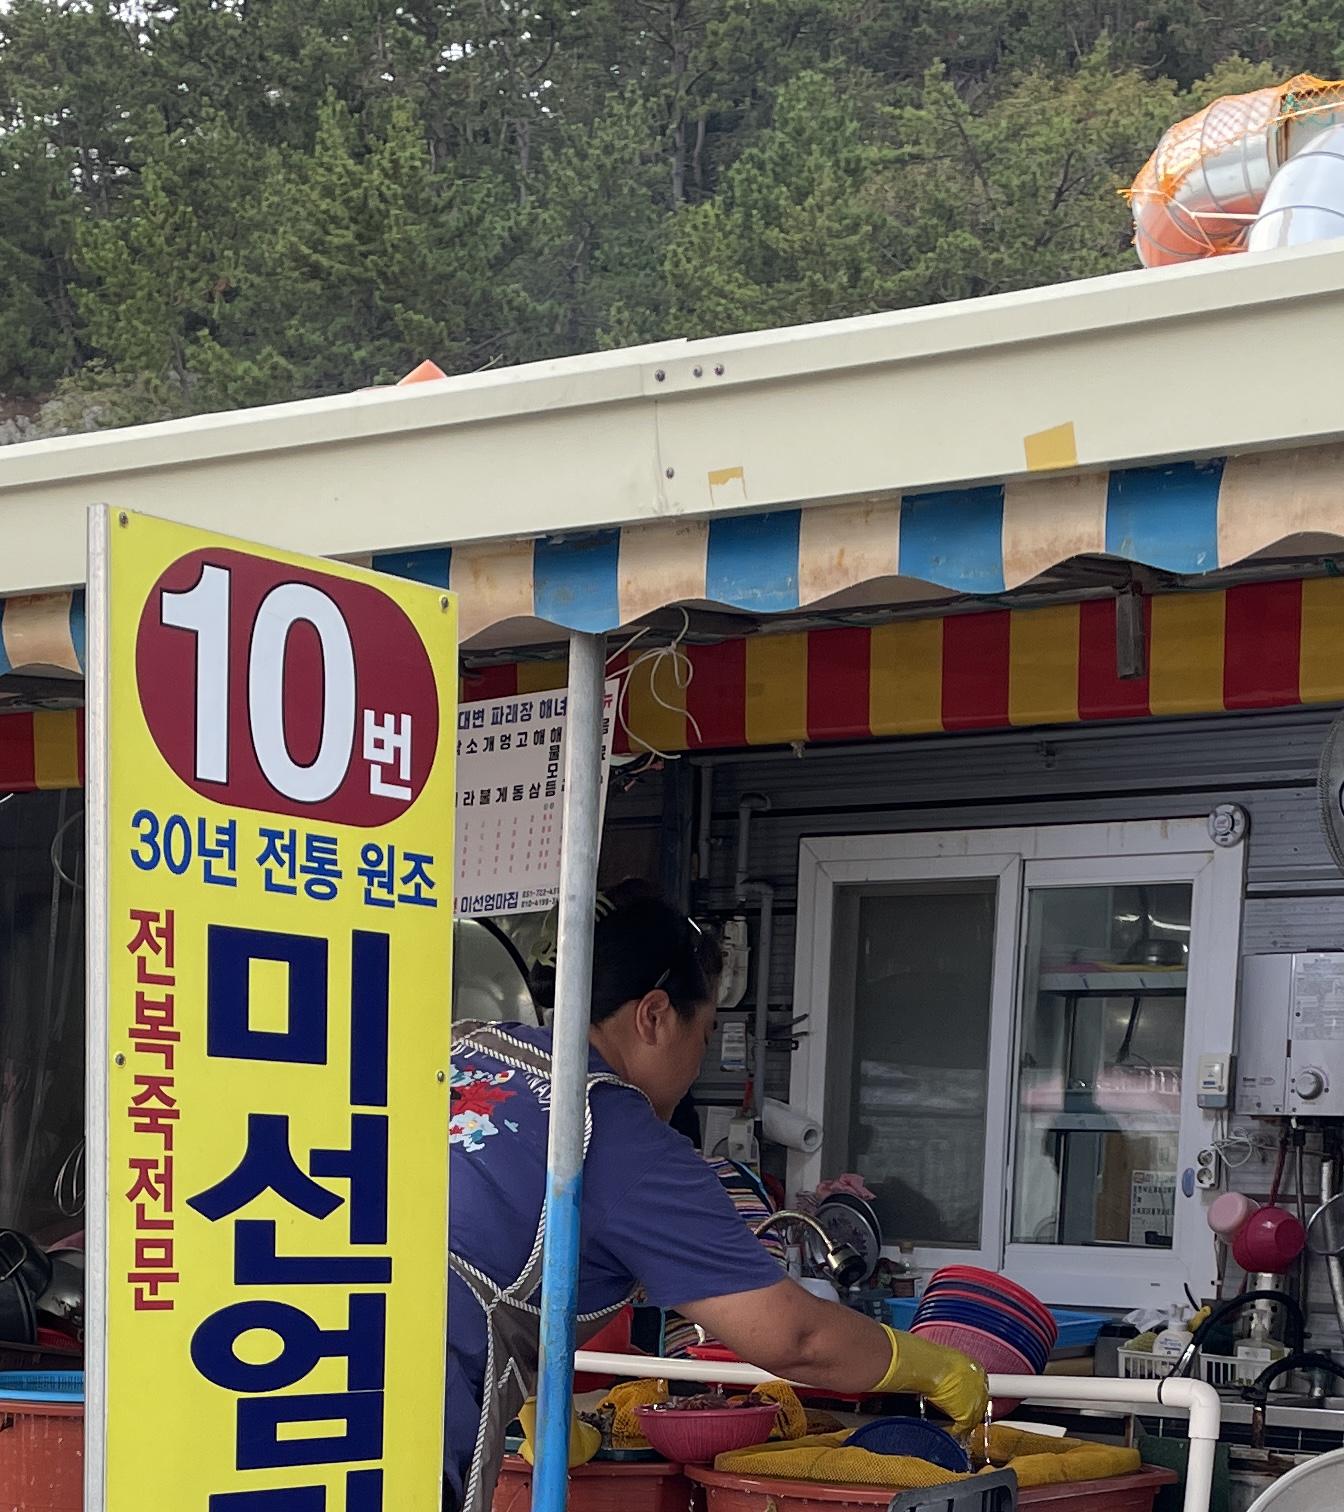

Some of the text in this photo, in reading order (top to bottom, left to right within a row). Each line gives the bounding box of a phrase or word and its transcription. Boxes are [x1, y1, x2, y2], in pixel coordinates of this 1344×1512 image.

[130, 810, 438, 909] 30년 전통 원조
[460, 891, 520, 914] 미선엄마집
[126, 908, 181, 1312] 전복죽전문
